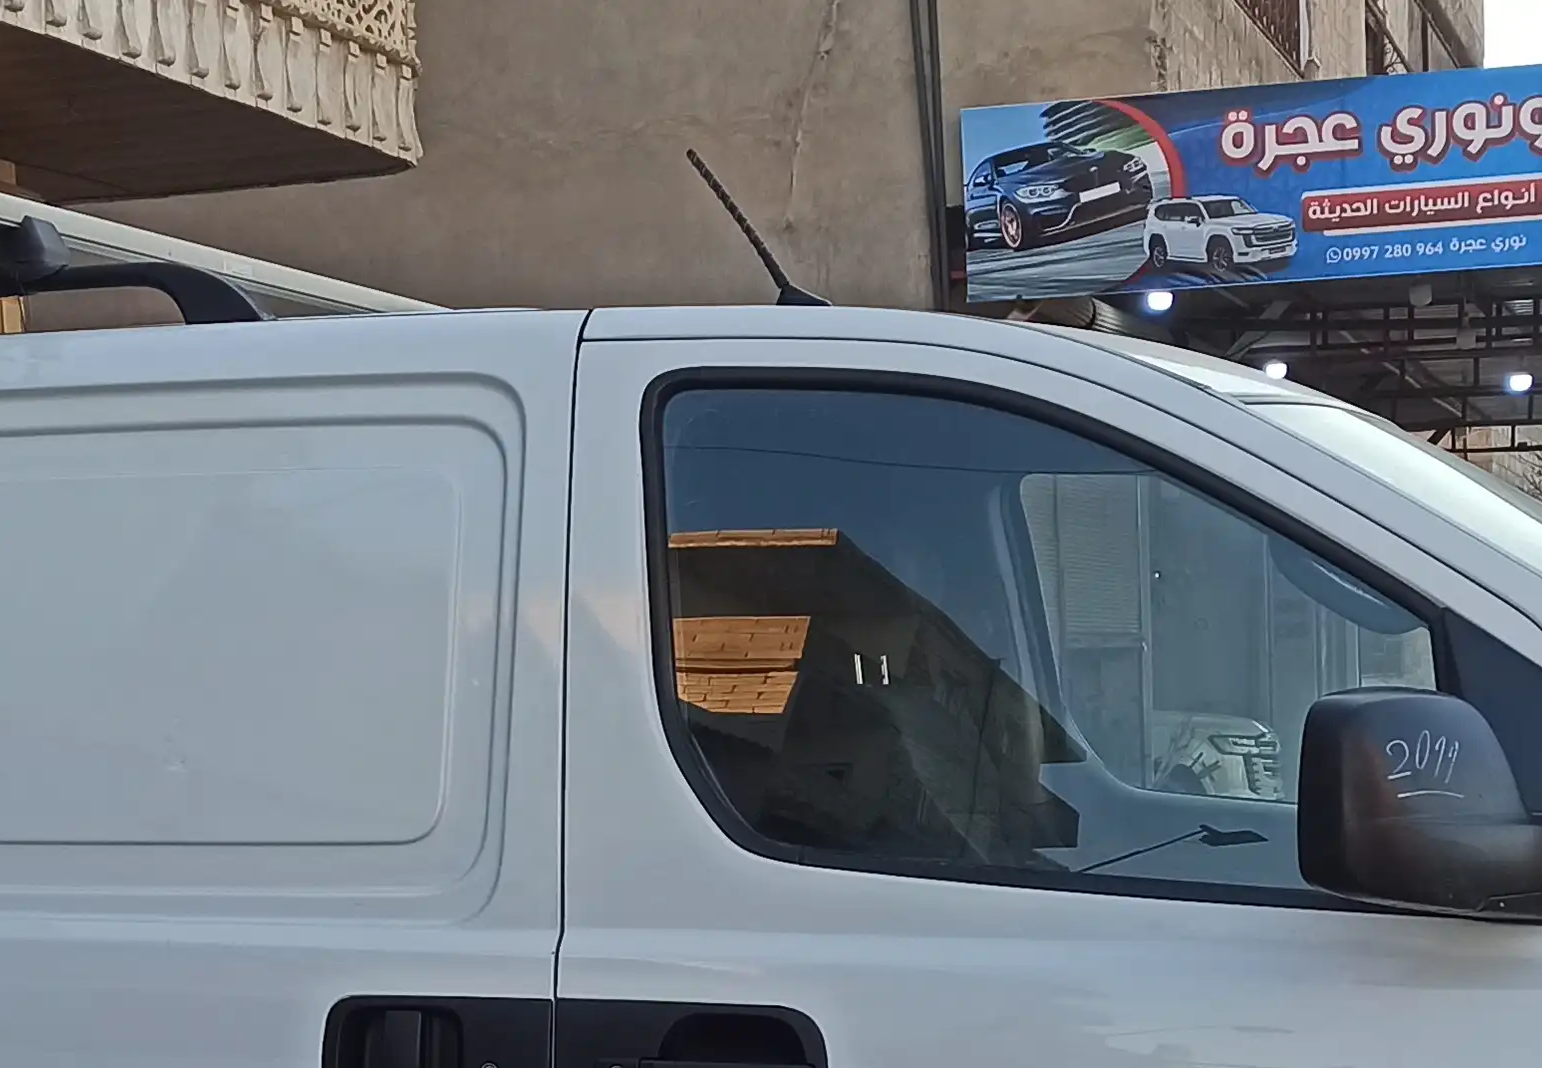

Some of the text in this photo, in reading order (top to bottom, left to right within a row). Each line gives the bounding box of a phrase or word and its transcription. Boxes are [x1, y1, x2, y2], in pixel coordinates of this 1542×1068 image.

[1220, 109, 1360, 172] عجرة
[1307, 197, 1378, 223] الحديثة
[1384, 191, 1470, 217] السيارات
[1342, 240, 1444, 262] 0997 280 964
[1449, 234, 1527, 253] نوري عجرة
